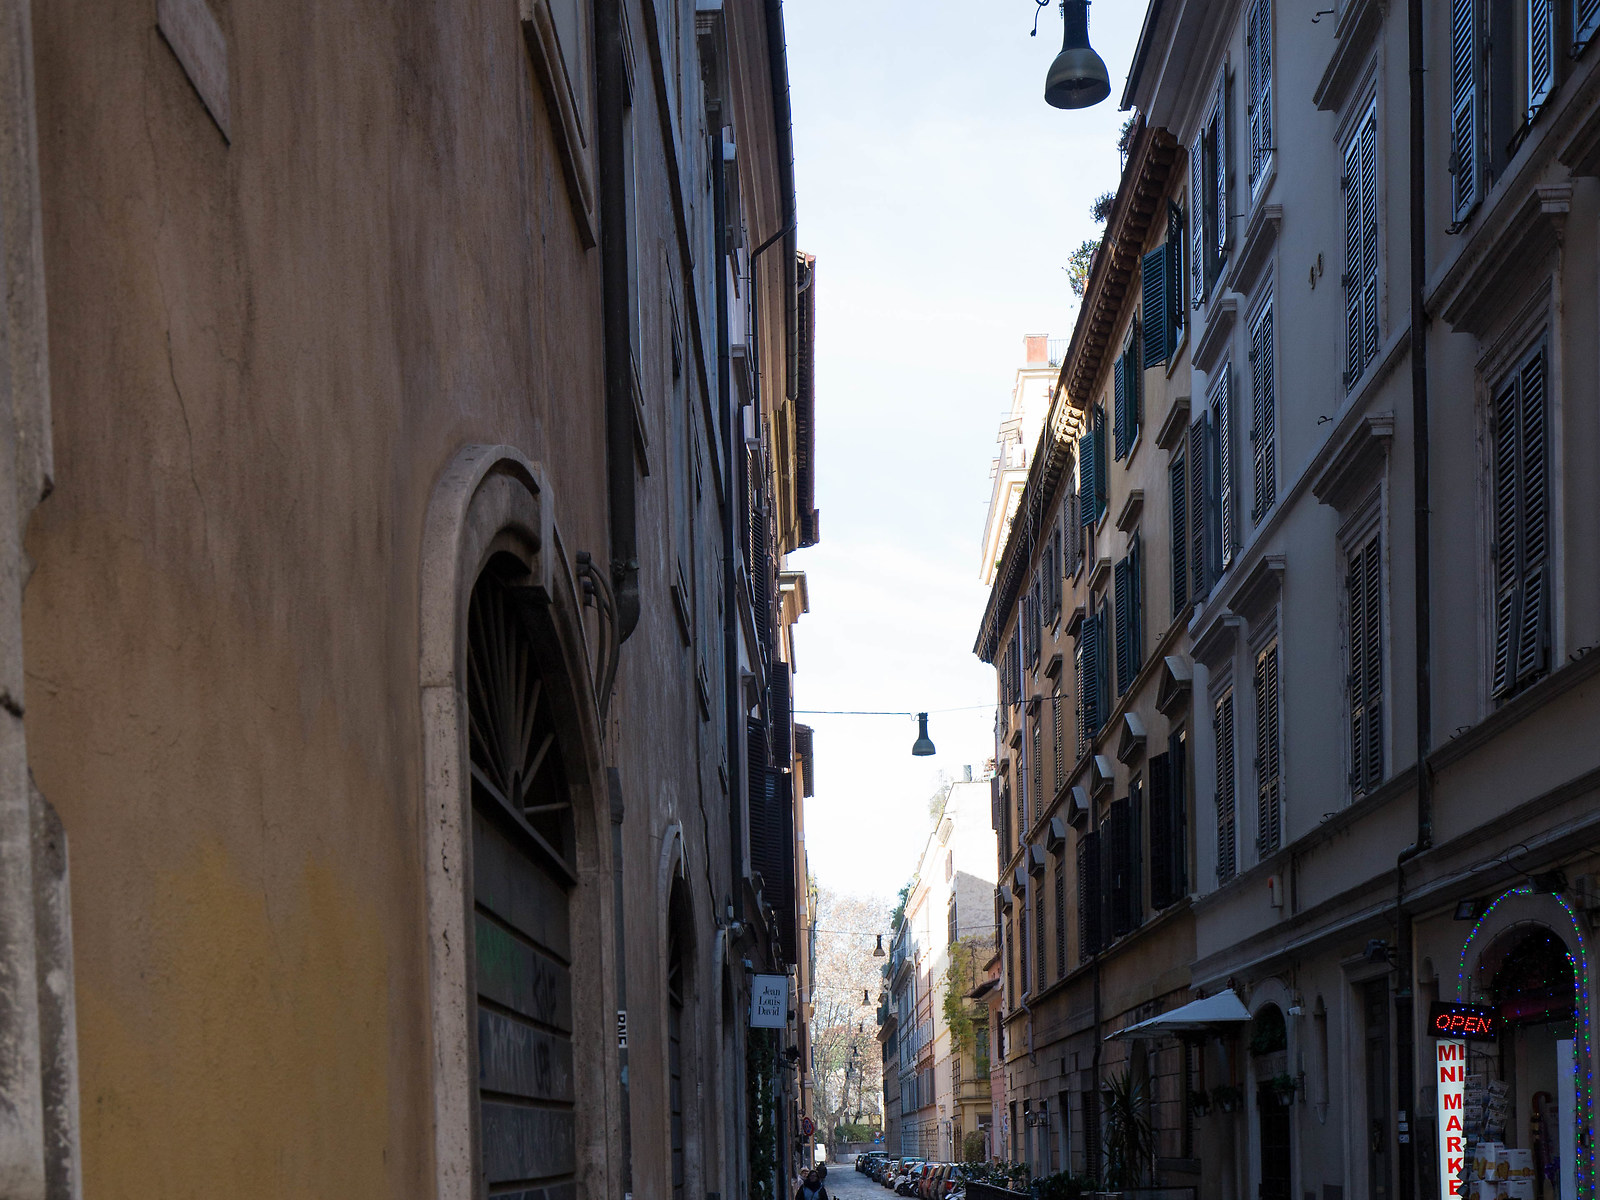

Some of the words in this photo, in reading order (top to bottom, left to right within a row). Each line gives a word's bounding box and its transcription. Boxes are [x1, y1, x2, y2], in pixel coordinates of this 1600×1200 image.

[763, 986, 780, 996] Jean
[759, 996, 780, 1005] Louis
[758, 1006, 779, 1016] David
[1436, 1014, 1491, 1032] OPEN
